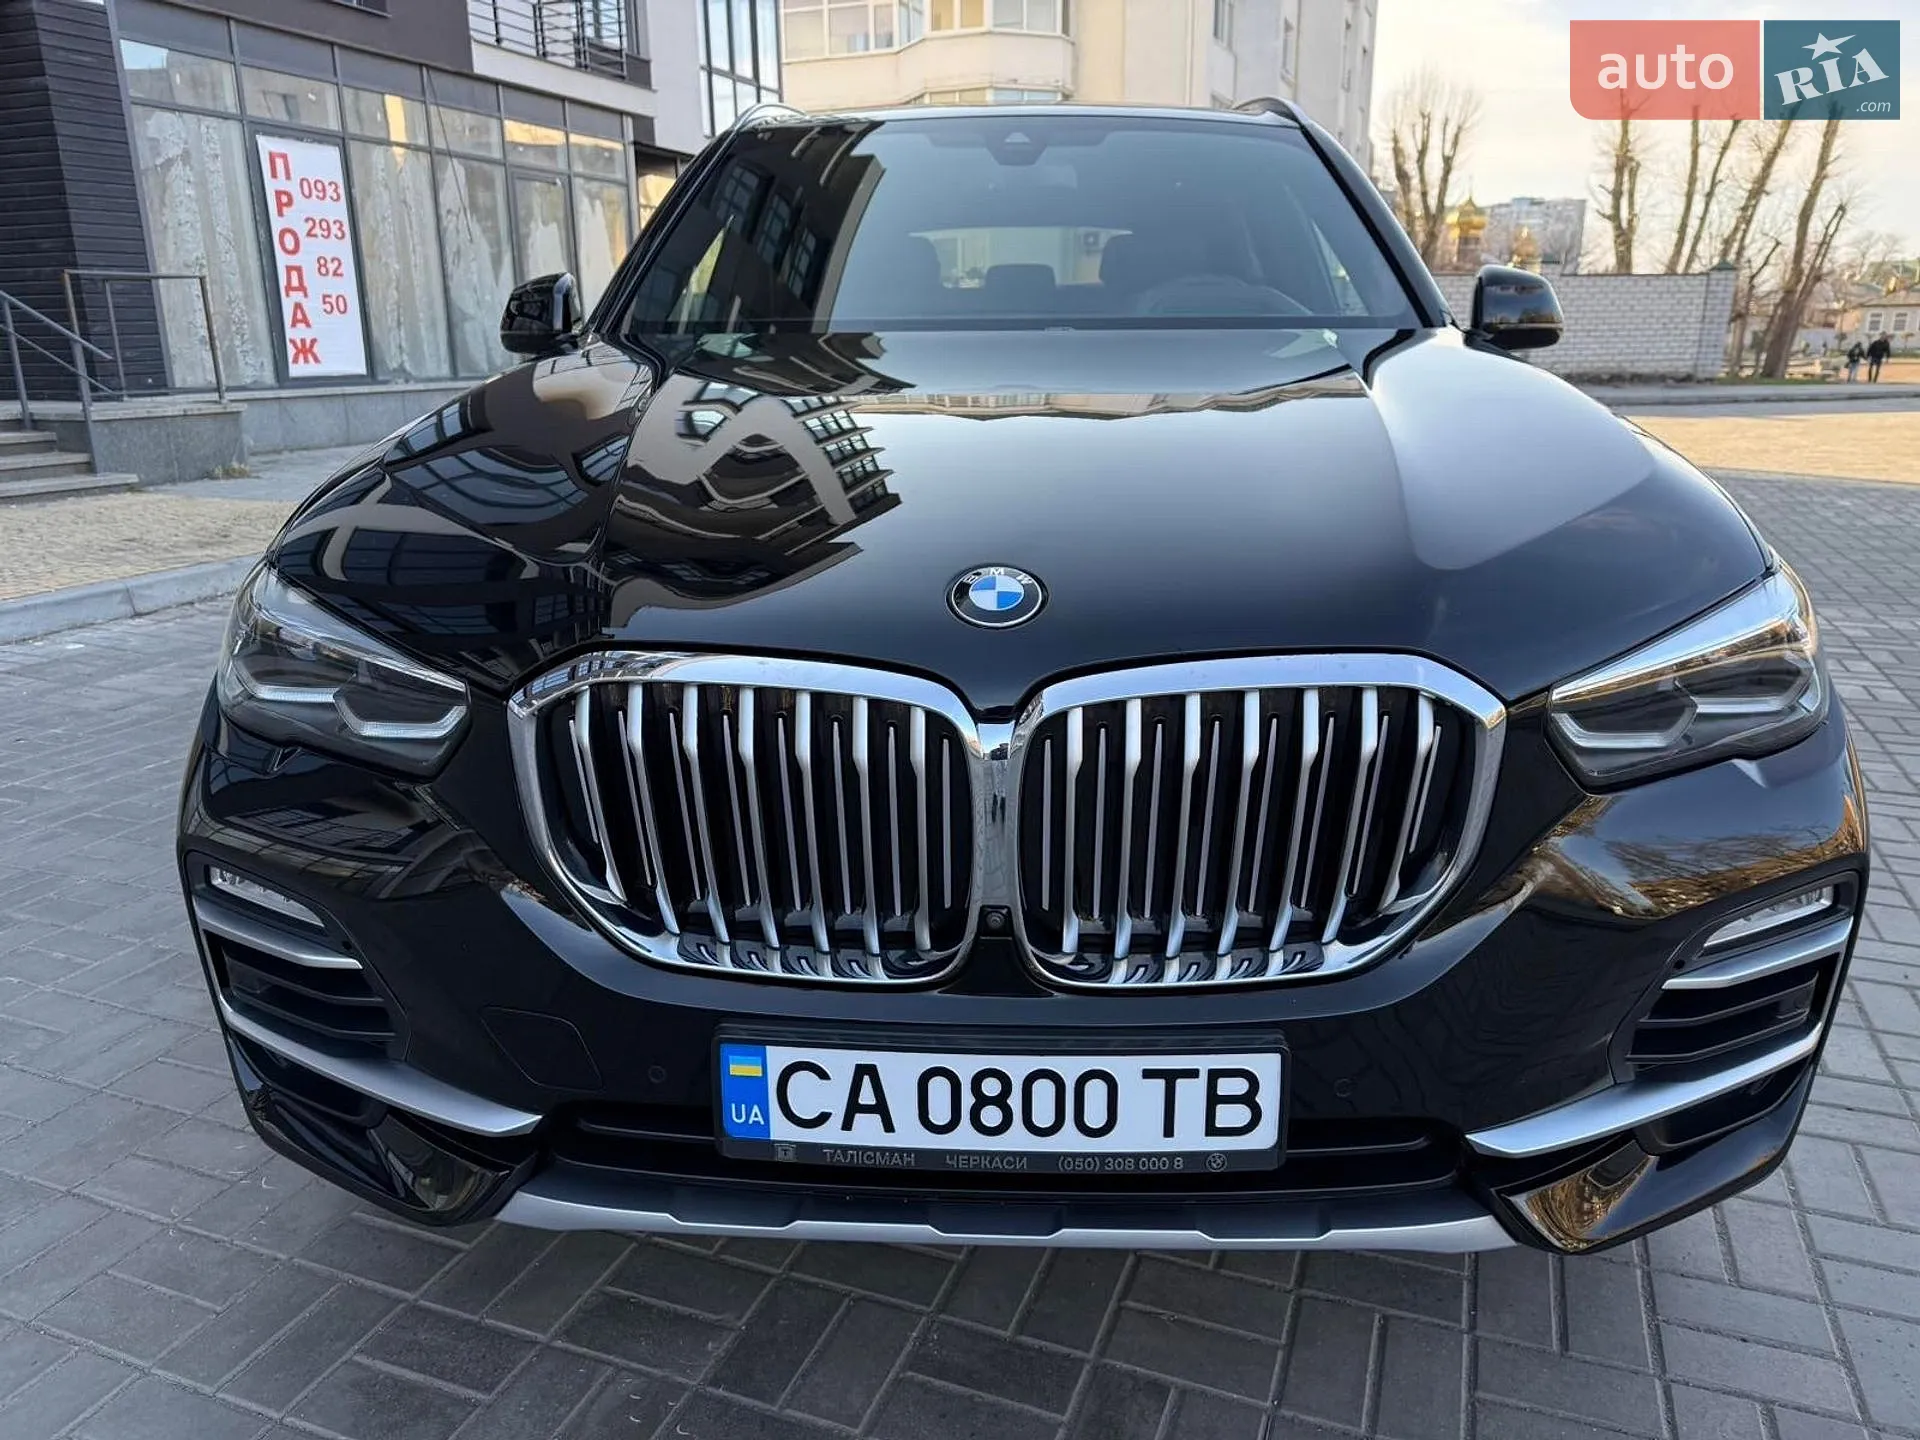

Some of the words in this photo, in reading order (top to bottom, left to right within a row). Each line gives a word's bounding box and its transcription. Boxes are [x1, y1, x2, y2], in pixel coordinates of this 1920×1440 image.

[299, 177, 341, 202] 093
[304, 216, 346, 240] 293
[268, 151, 321, 364] ПРОДАЖ
[316, 255, 344, 277] 82
[322, 294, 348, 315] 50
[776, 1060, 896, 1134] CA
[917, 1065, 1118, 1138] 0800
[1142, 1068, 1263, 1138] TB
[731, 1103, 765, 1126] UA
[822, 1149, 916, 1168] ТАЛІСМАН
[945, 1155, 1028, 1173] ЧЕРКАСИ
[1058, 1155, 1100, 1172] (050)
